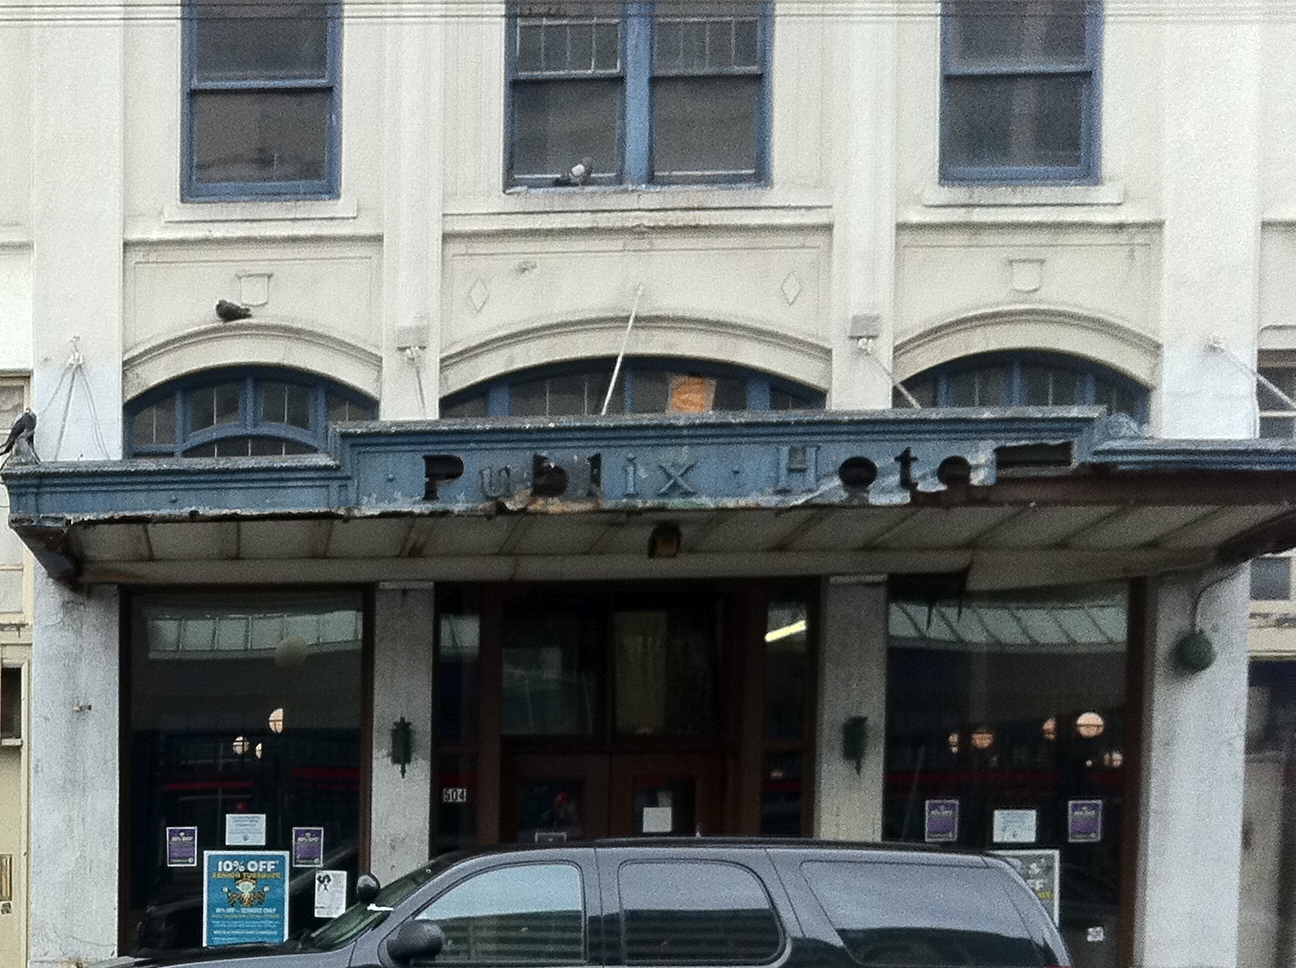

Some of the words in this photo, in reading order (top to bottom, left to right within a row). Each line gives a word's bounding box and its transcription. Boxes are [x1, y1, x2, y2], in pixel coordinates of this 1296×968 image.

[421, 452, 700, 501] Publix
[444, 788, 465, 801] 504
[218, 860, 245, 872] 10%
